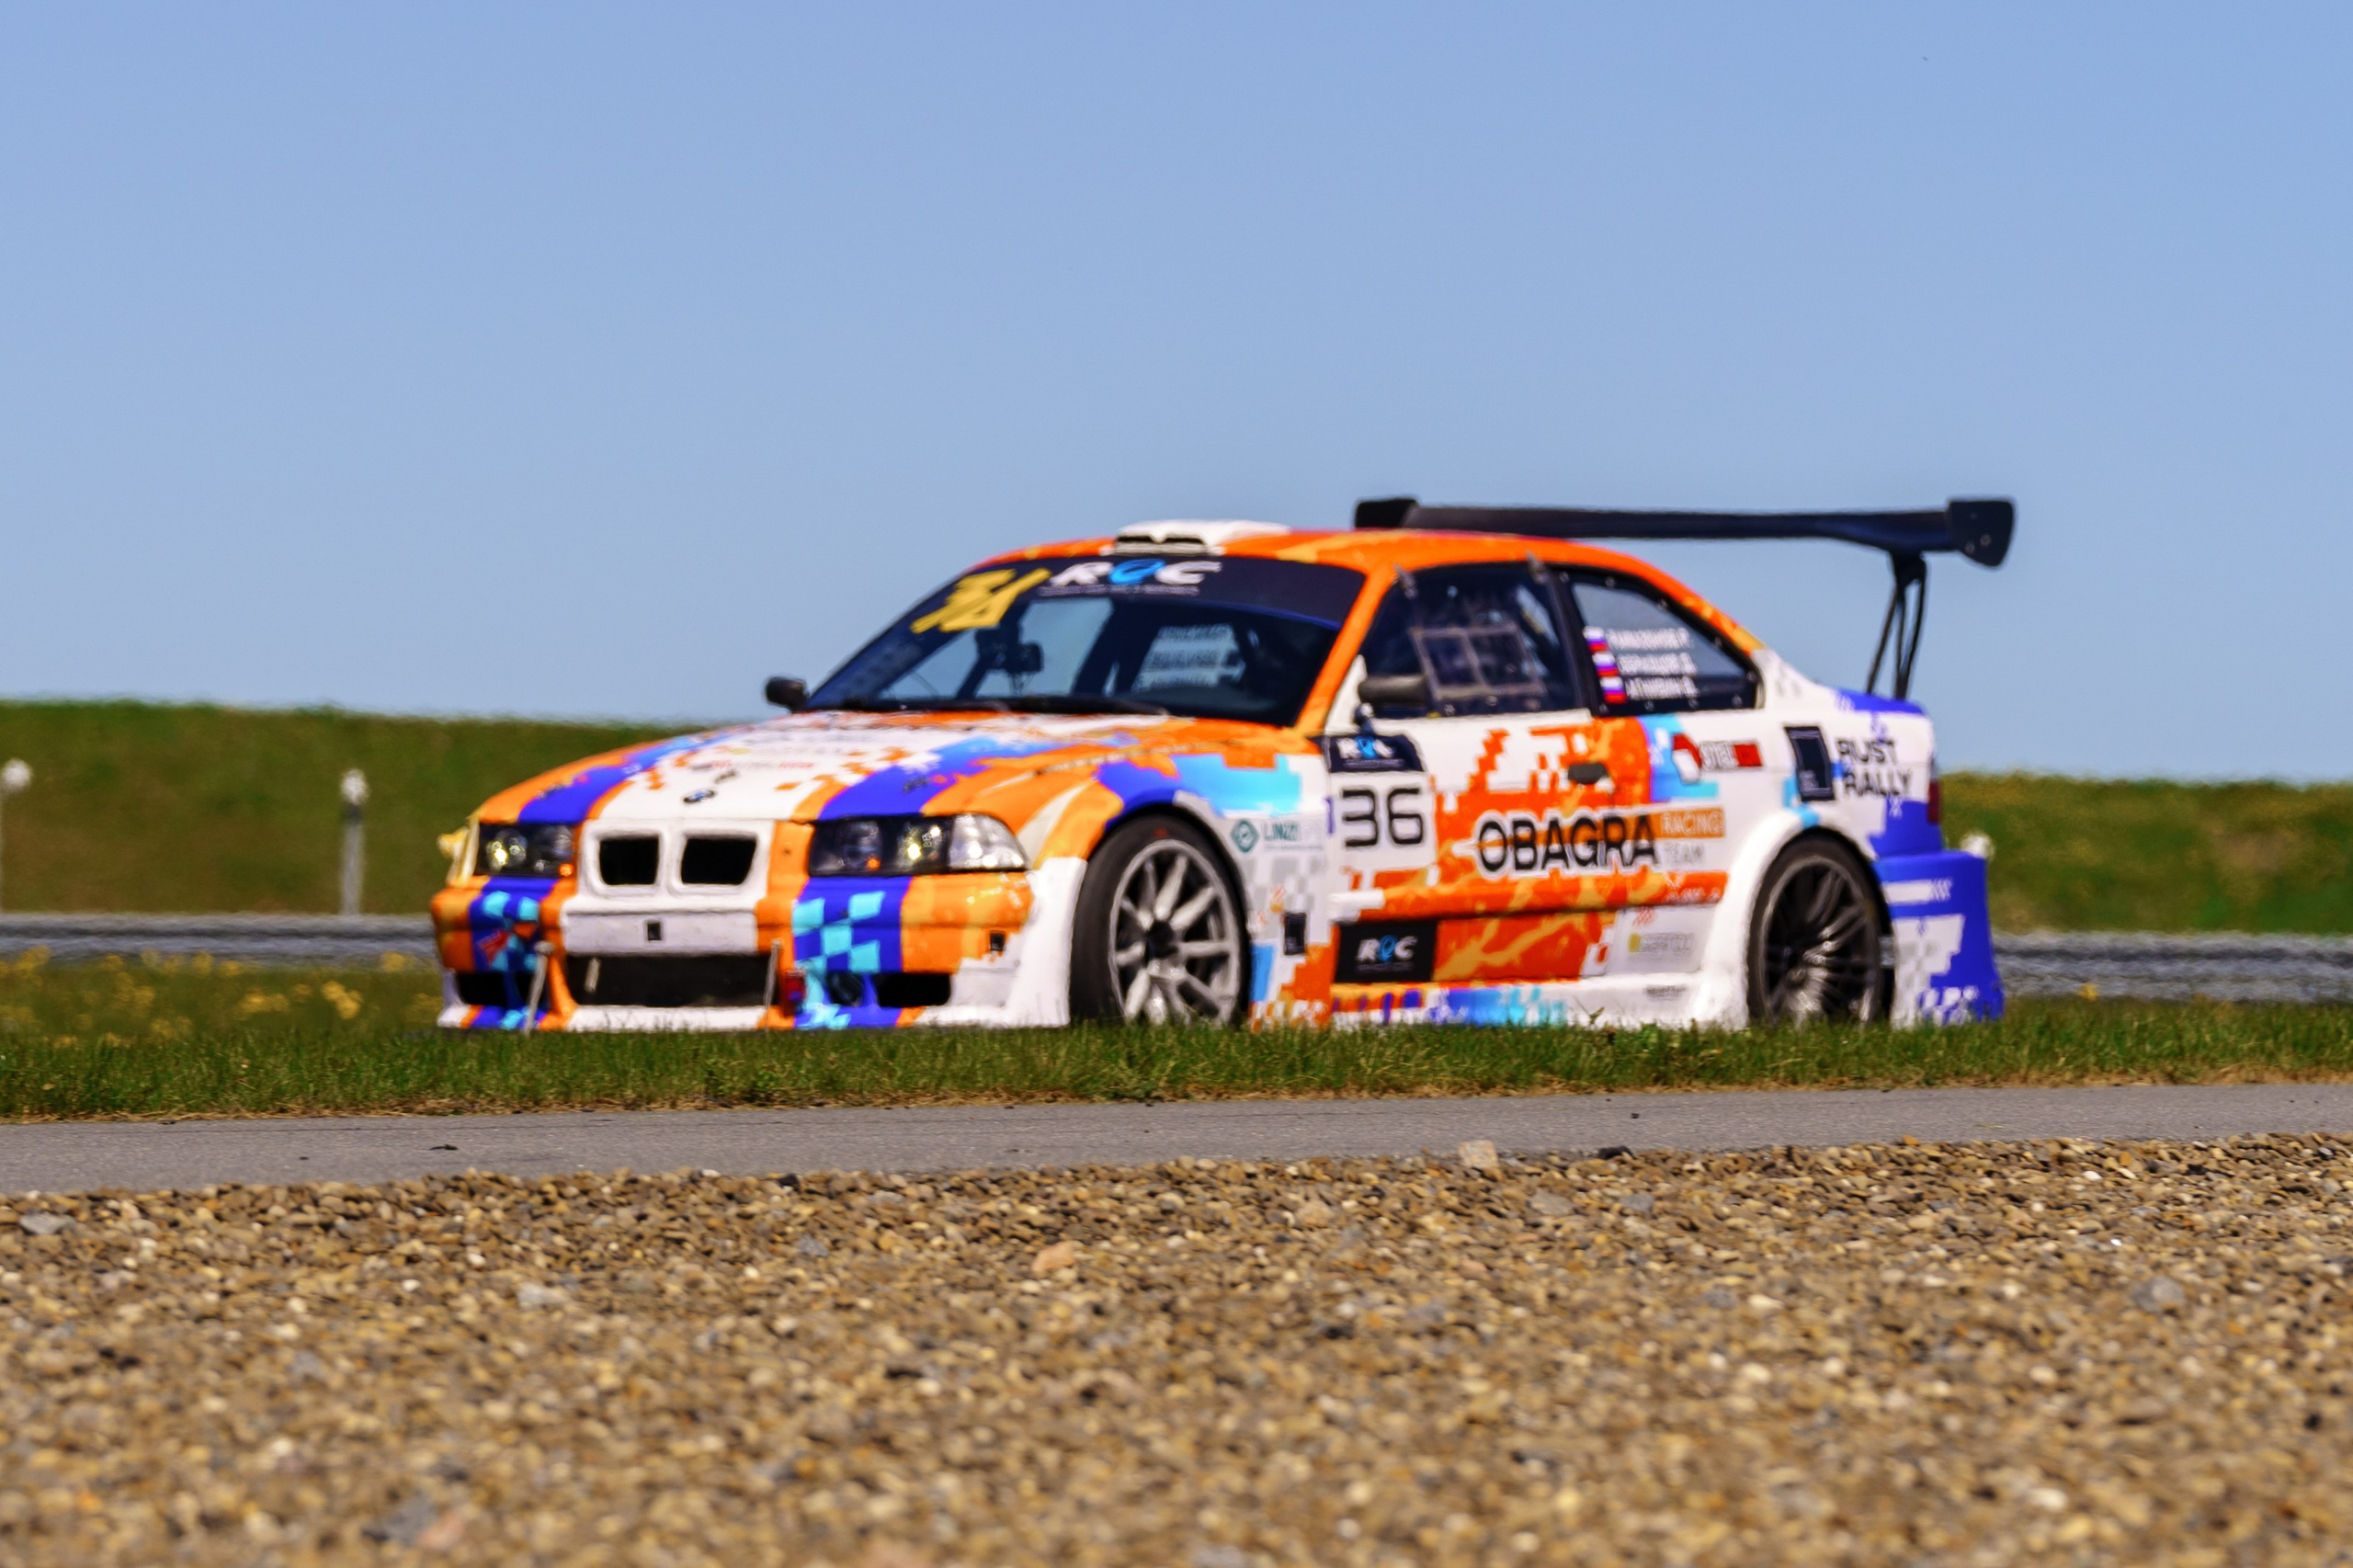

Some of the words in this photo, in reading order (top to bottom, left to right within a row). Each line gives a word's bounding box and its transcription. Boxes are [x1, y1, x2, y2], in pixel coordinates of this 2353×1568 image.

[1836, 739, 1897, 764] RUST
[1845, 768, 1911, 797] RALLY
[1342, 788, 1425, 846] 36
[1660, 810, 1722, 837] RACING
[1478, 814, 1656, 872] OBAGRA
[1664, 841, 1706, 864] TEAM
